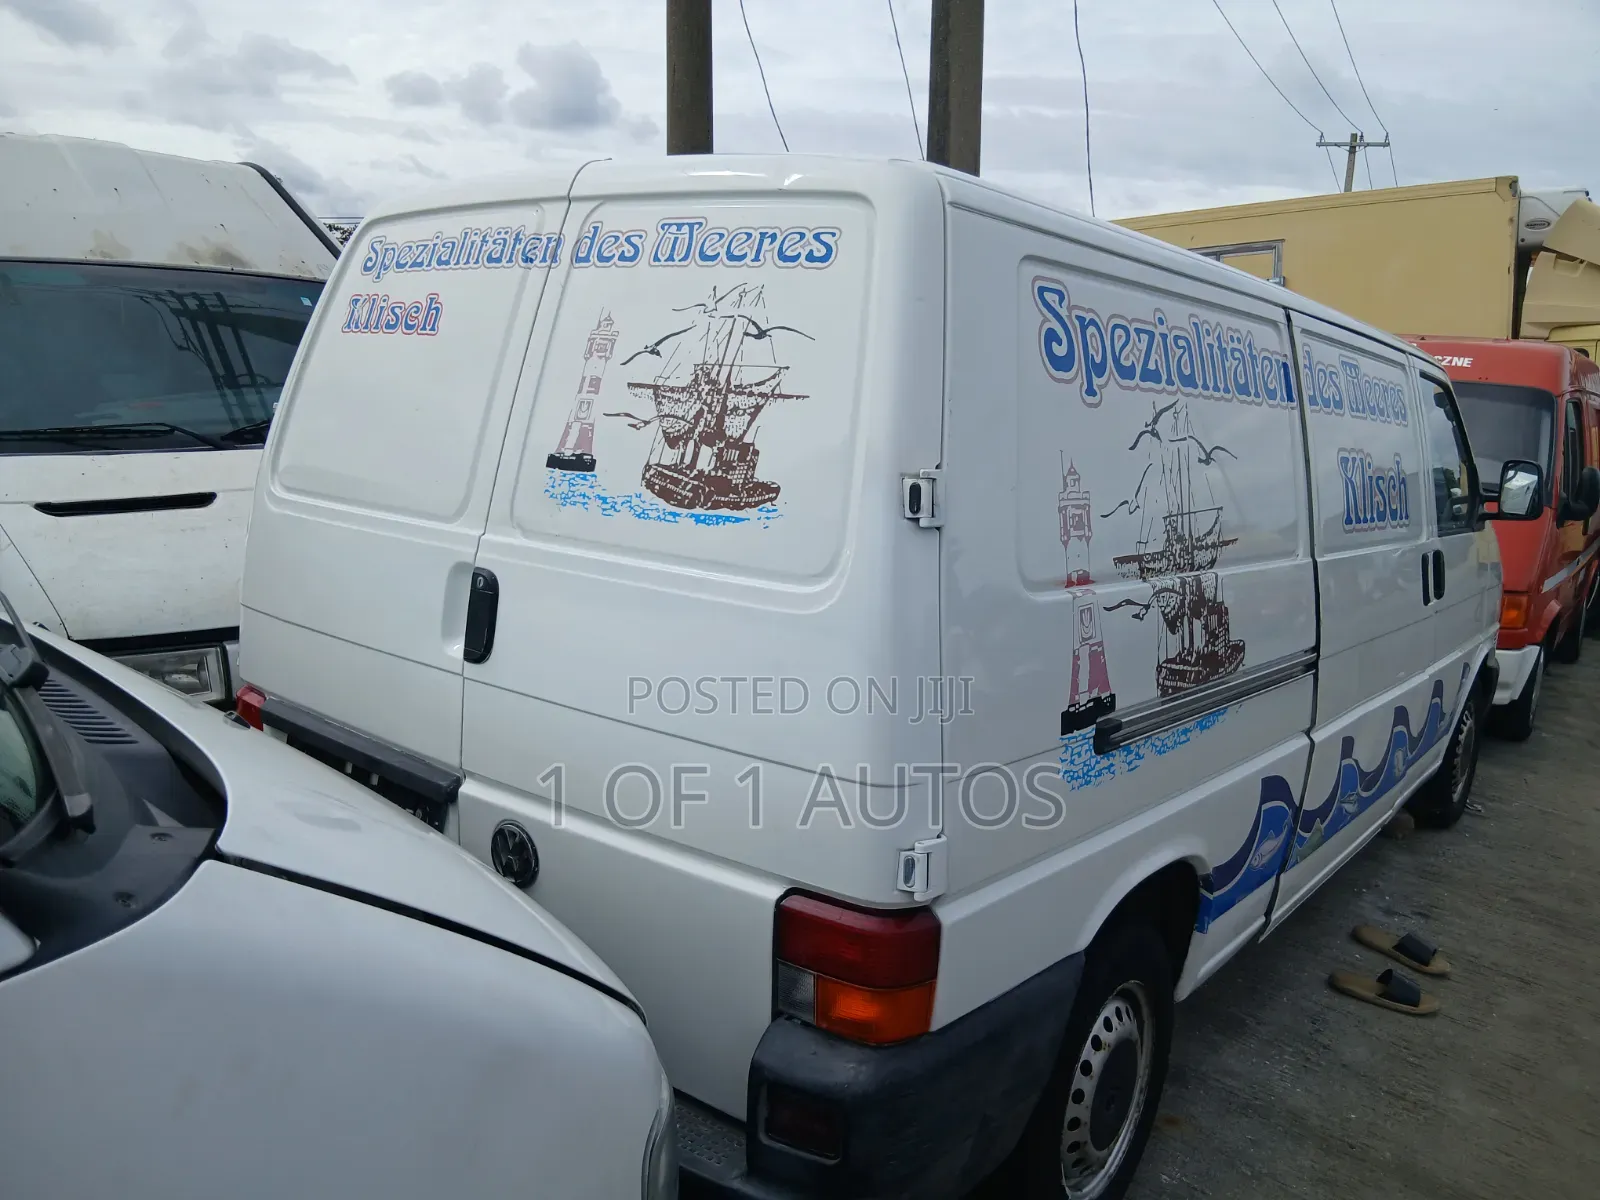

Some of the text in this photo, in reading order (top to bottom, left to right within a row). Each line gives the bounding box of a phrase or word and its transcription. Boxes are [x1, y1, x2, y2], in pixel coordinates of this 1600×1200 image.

[361, 218, 841, 282] Spezialitäten des Meeres
[342, 293, 443, 335] Klisch
[1033, 276, 1408, 426] Spezialitäten des Meeres
[1338, 448, 1410, 534] Klisch
